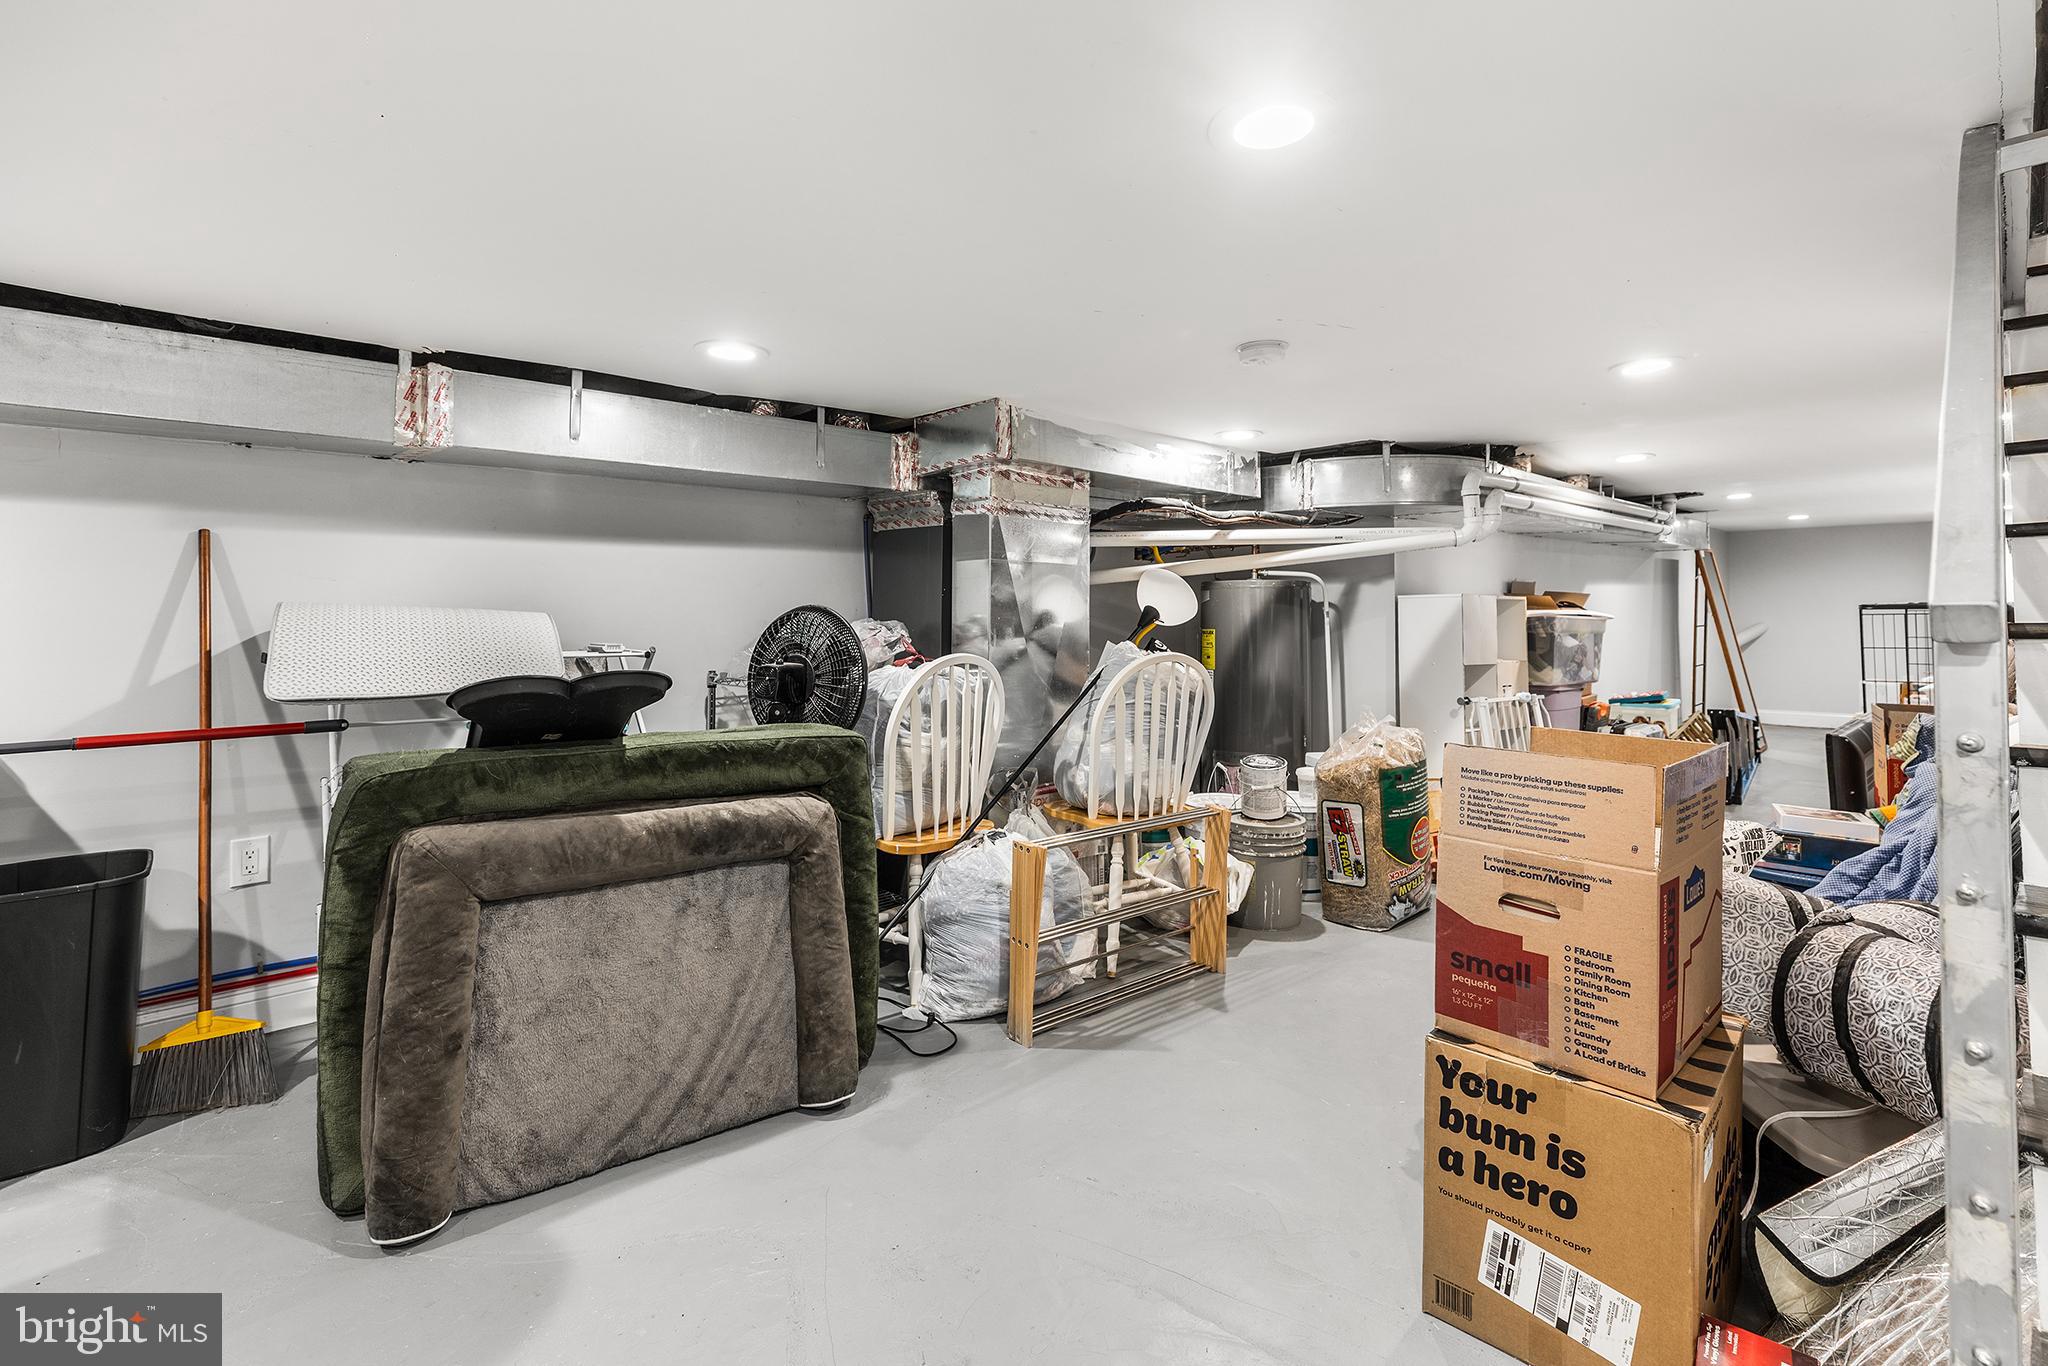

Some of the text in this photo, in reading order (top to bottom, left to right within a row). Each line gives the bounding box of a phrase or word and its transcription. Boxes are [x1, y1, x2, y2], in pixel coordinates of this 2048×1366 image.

[1461, 767, 1480, 775] Move
[1524, 776, 1551, 785] picking
[1564, 781, 1586, 789] these
[1588, 784, 1624, 794] supplies:
[1511, 781, 1539, 789] recogiendo
[1468, 787, 1490, 795] Packing
[1491, 790, 1504, 798] Tape
[1523, 795, 1546, 803] adhesiva
[1467, 808, 1489, 816] Packing
[1487, 804, 1510, 812] Cushion
[1467, 814, 1491, 822] Furniture
[1467, 821, 1486, 830] Moving
[1488, 825, 1511, 833] Blankets
[1484, 862, 1591, 892] Lowes.com/Moving
[1568, 872, 1598, 883] smoothly,
[1574, 947, 1613, 962] FRAGILE
[1450, 951, 1530, 989] small
[1574, 957, 1614, 973] Bedroom
[1451, 973, 1497, 992] pequeña
[1574, 968, 1631, 988] Family Room
[1574, 978, 1630, 998] Dining Room
[1574, 987, 1608, 1003] Kitchen
[1462, 999, 1473, 1008] CU
[1574, 998, 1595, 1010] Bath
[1574, 1008, 1619, 1027] Basement
[1574, 1019, 1596, 1030] Attic
[1574, 1028, 1611, 1046] Laundry
[1574, 1038, 1608, 1055] Garage
[1574, 1049, 1646, 1077] A Load of Bricks
[1435, 1054, 1537, 1115] Your
[1439, 1095, 1587, 1179] bum is
[1438, 1146, 1578, 1220] a hero
[1438, 1185, 1592, 1256] You should probably get it a cape?
[1588, 1304, 1595, 1315] PA
[1712, 1325, 1720, 1347] Gloves
